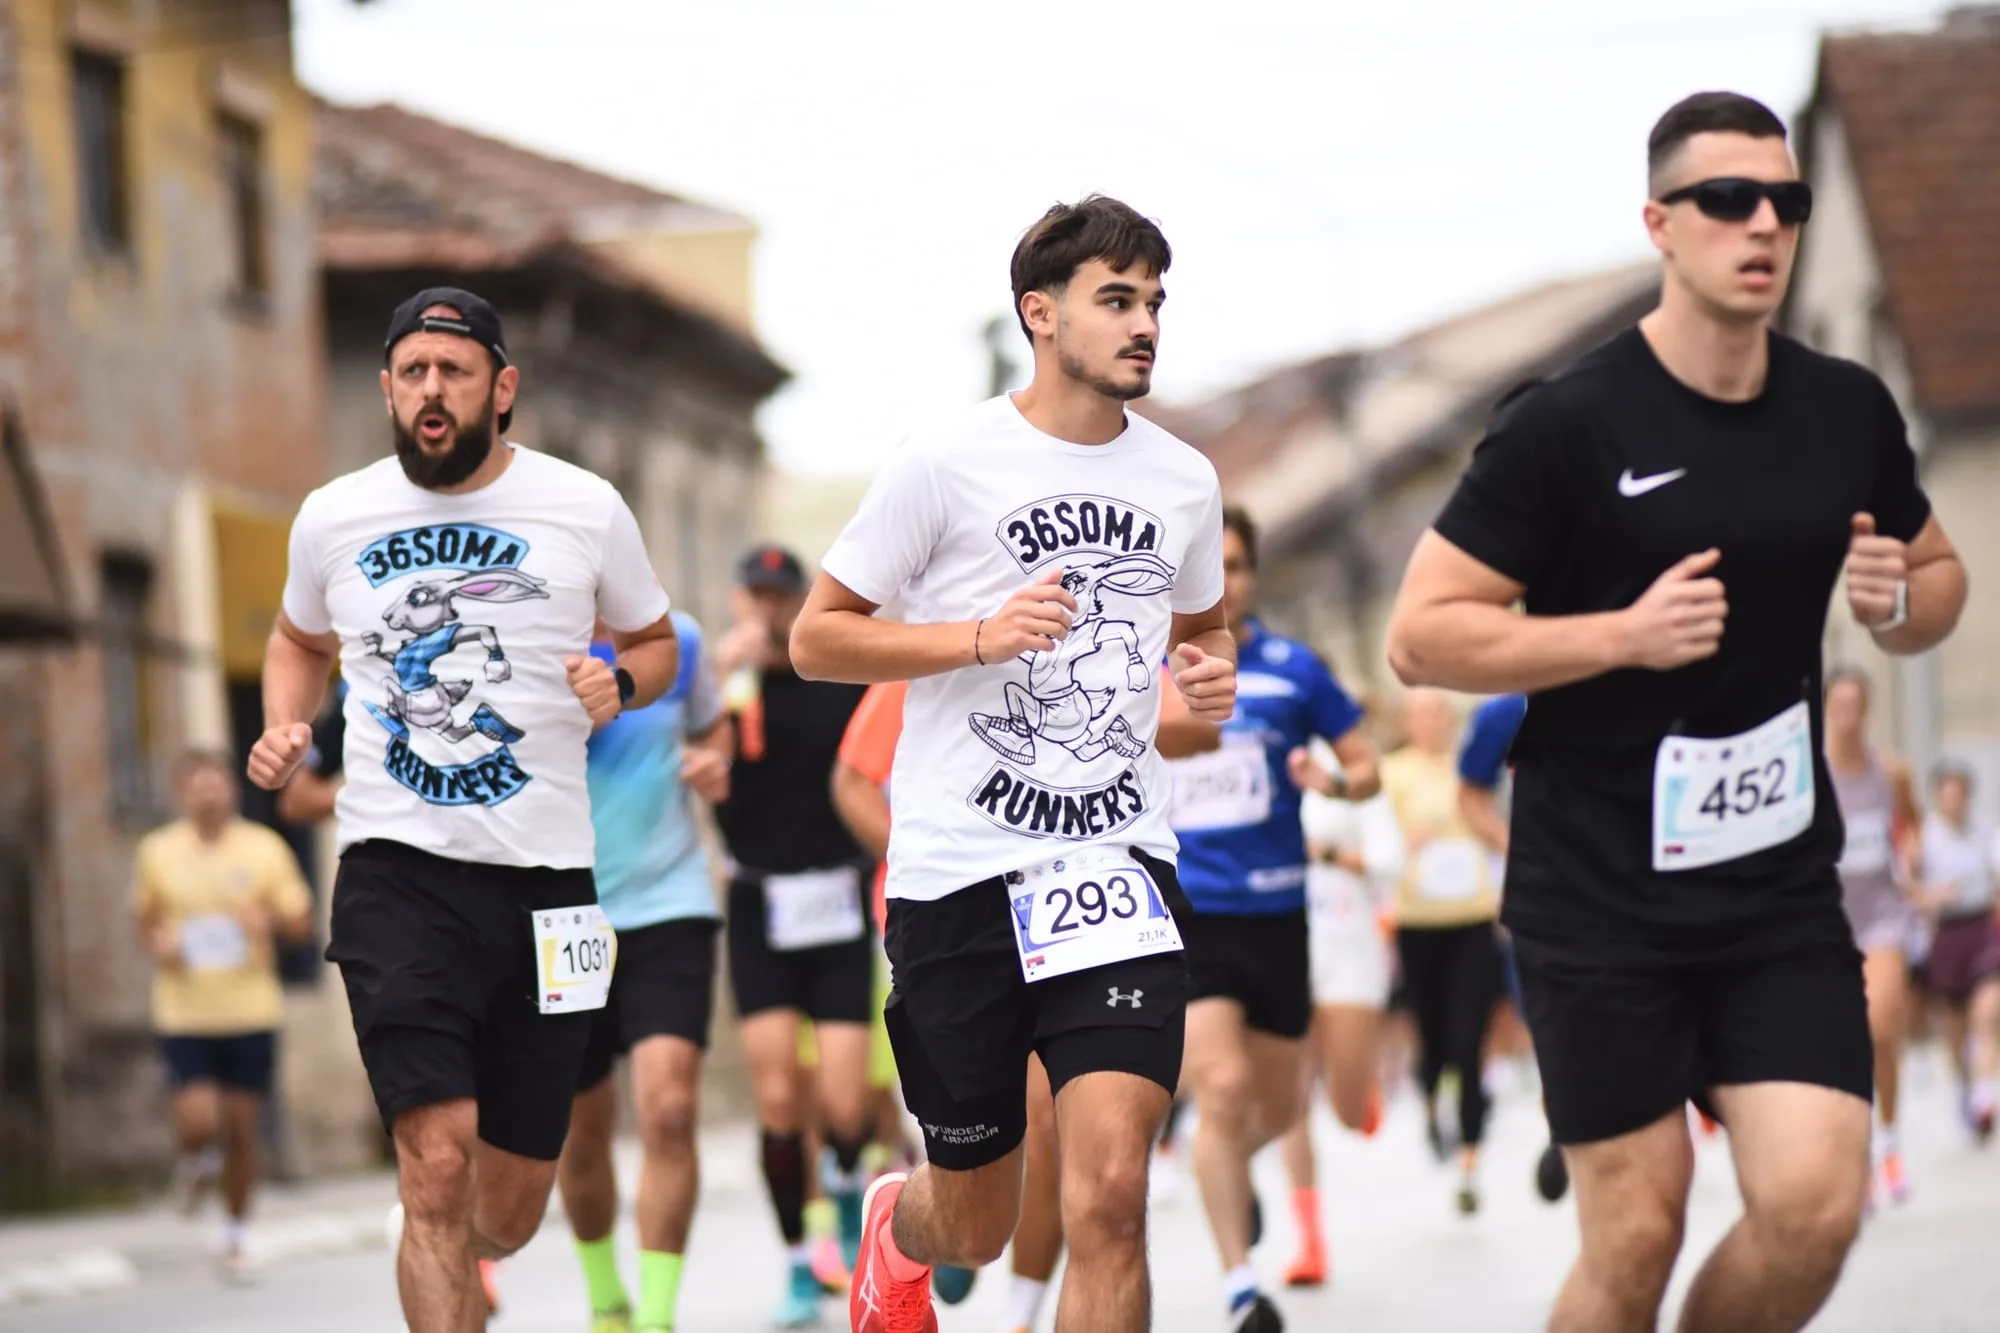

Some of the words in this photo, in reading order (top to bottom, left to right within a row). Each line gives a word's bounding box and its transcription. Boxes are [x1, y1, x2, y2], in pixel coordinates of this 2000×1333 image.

[365, 527, 521, 580] 36SOMA
[1007, 500, 1157, 563] 36SOMA
[388, 740, 526, 802] RUNNERS
[1698, 757, 1786, 820] 452
[974, 770, 1144, 836] RUNNERS
[1045, 876, 1138, 934] 293
[563, 937, 609, 973] 1031
[941, 1124, 985, 1136] UNDER
[942, 1126, 999, 1144] ARMOUR
